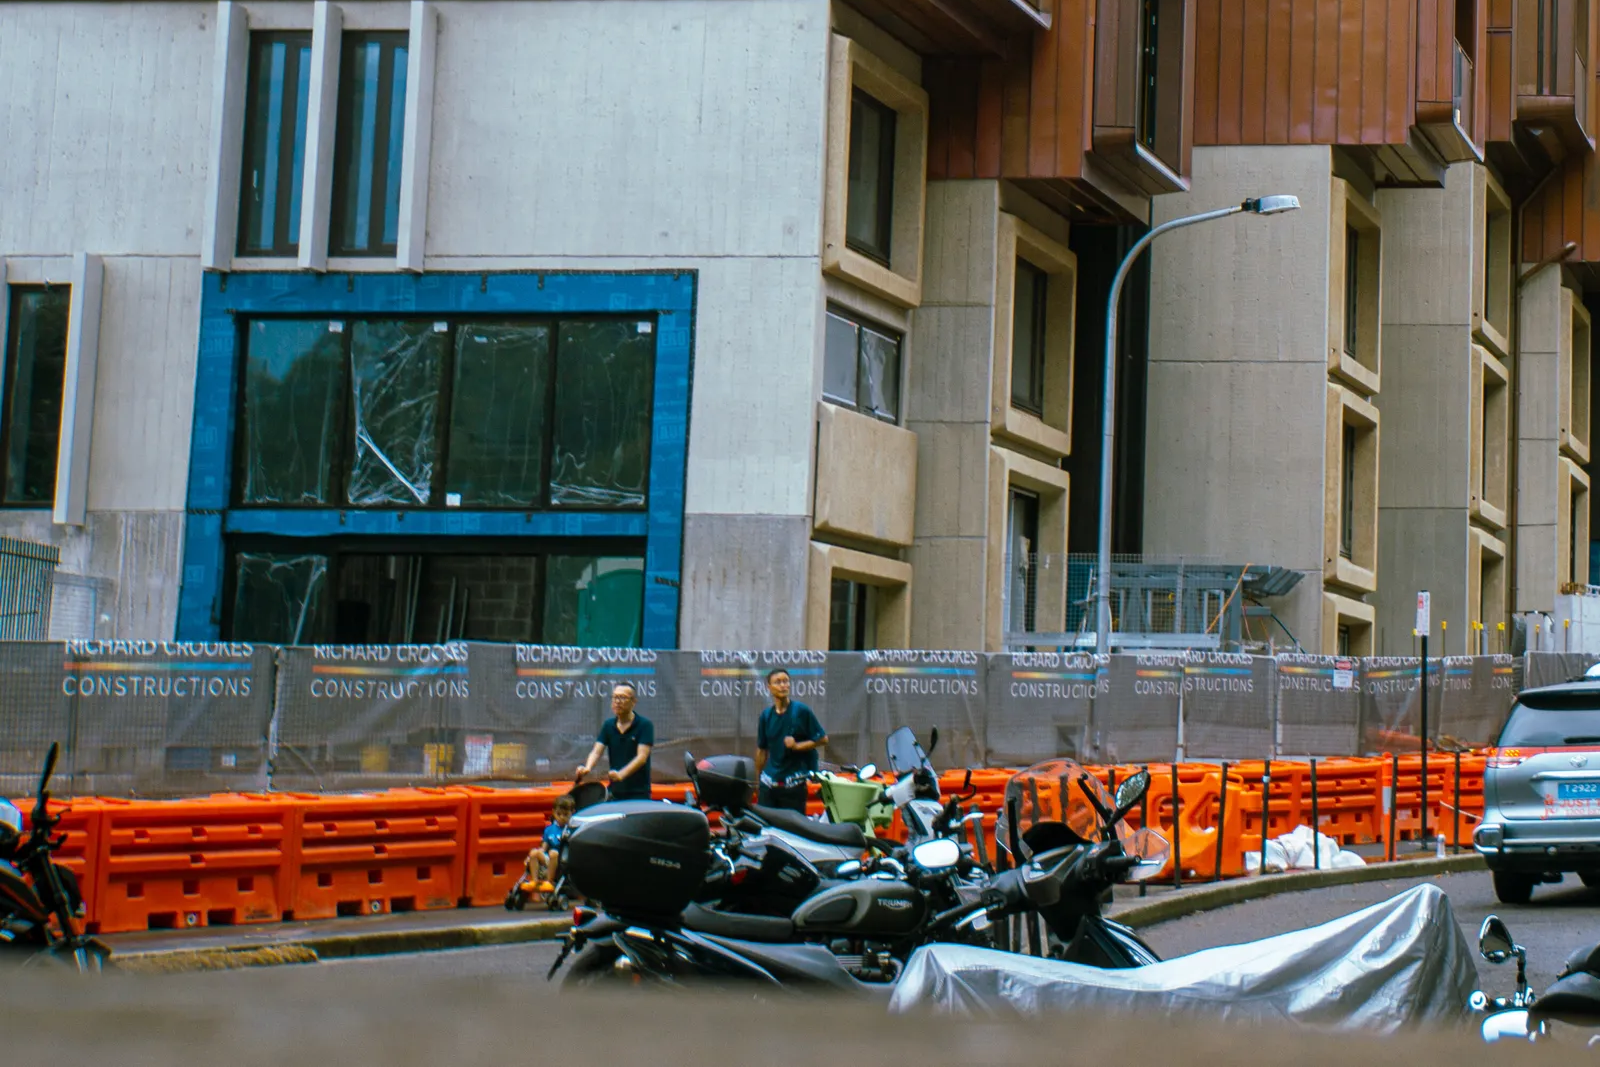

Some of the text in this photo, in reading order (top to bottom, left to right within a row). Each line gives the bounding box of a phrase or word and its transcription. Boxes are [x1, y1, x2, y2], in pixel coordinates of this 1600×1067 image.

[515, 644, 583, 663] RICHARD
[1011, 652, 1060, 668] RICHARD
[62, 675, 252, 697] CONSTRUCTIONS
[310, 678, 470, 699] CONSTRUCTIONS
[515, 679, 657, 699] CONSTRUCTNS
[700, 680, 827, 697] CONSTRUIONS
[865, 678, 978, 696] CONSTRUCTIONS
[1559, 799, 1591, 808] JUST
